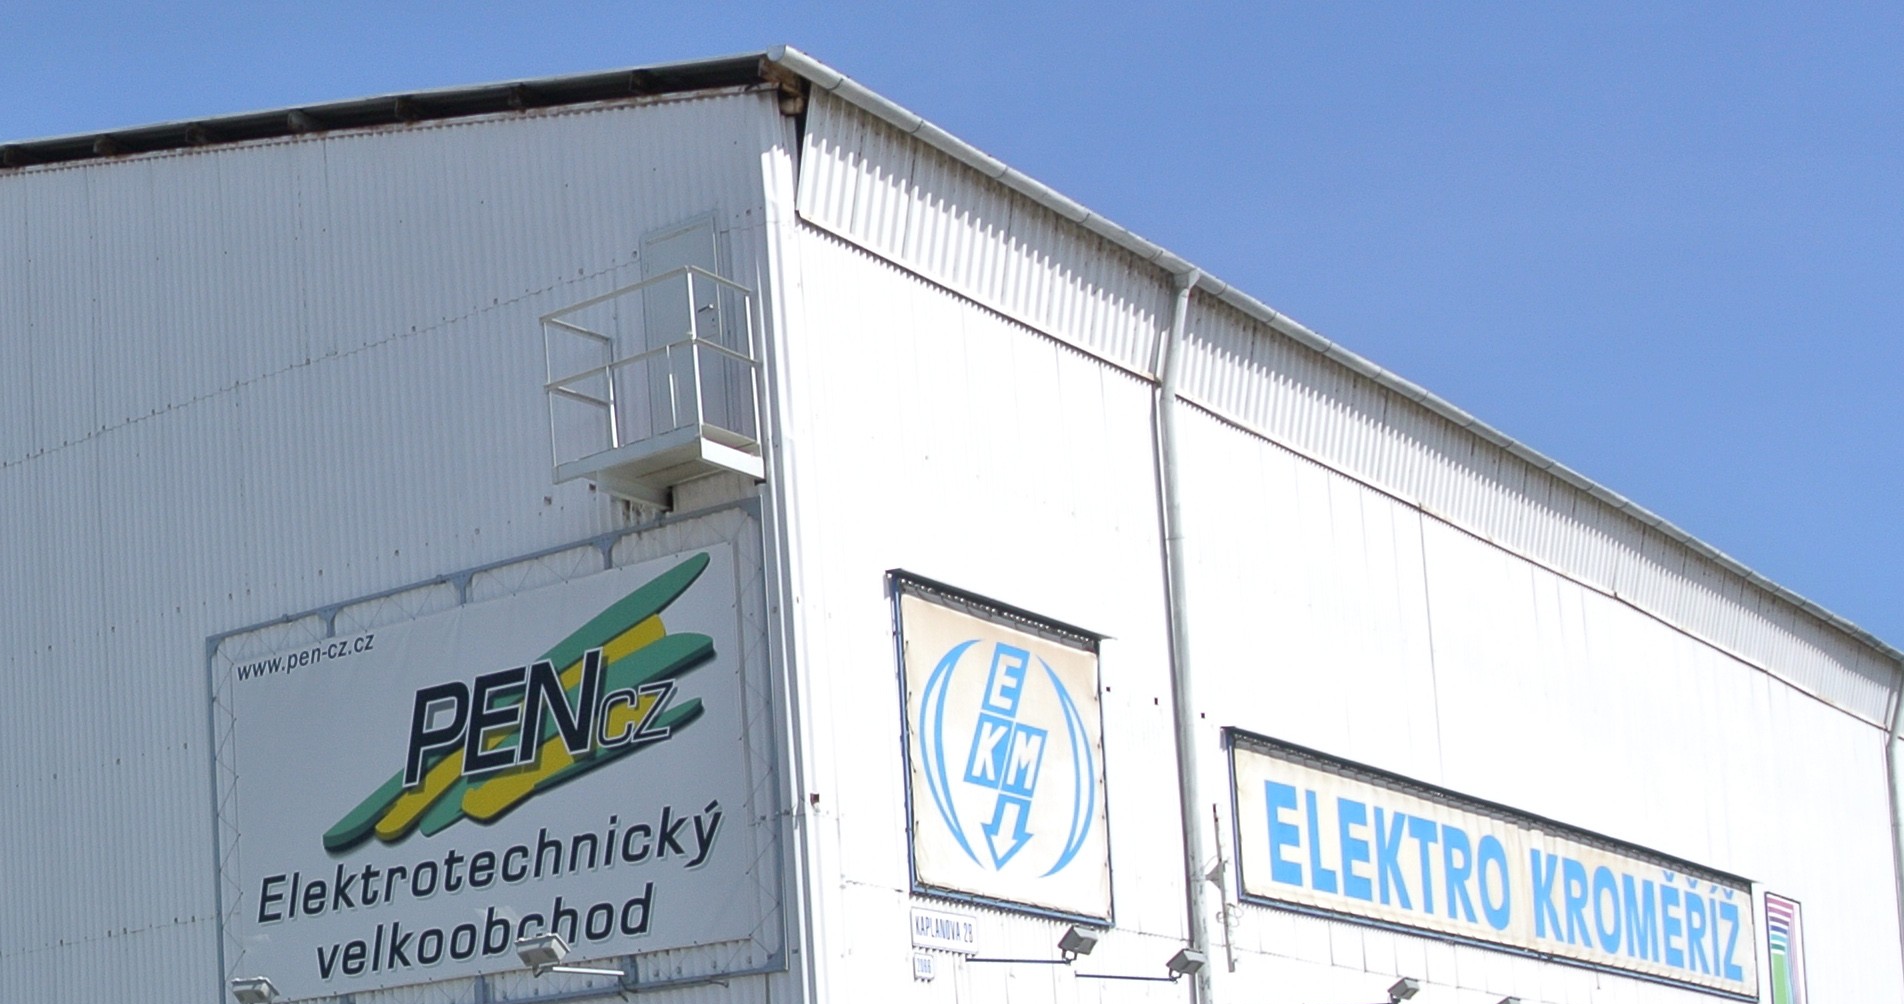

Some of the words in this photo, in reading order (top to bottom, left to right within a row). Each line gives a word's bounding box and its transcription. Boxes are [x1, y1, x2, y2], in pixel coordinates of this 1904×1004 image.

[238, 633, 374, 682] www.pen-cz.cz
[256, 799, 723, 926] Elektrotechnický
[1264, 779, 1512, 931] ELEKTRO
[1529, 846, 1745, 983] KROMĚŘÍŽ
[316, 882, 655, 981] velkoobchod
